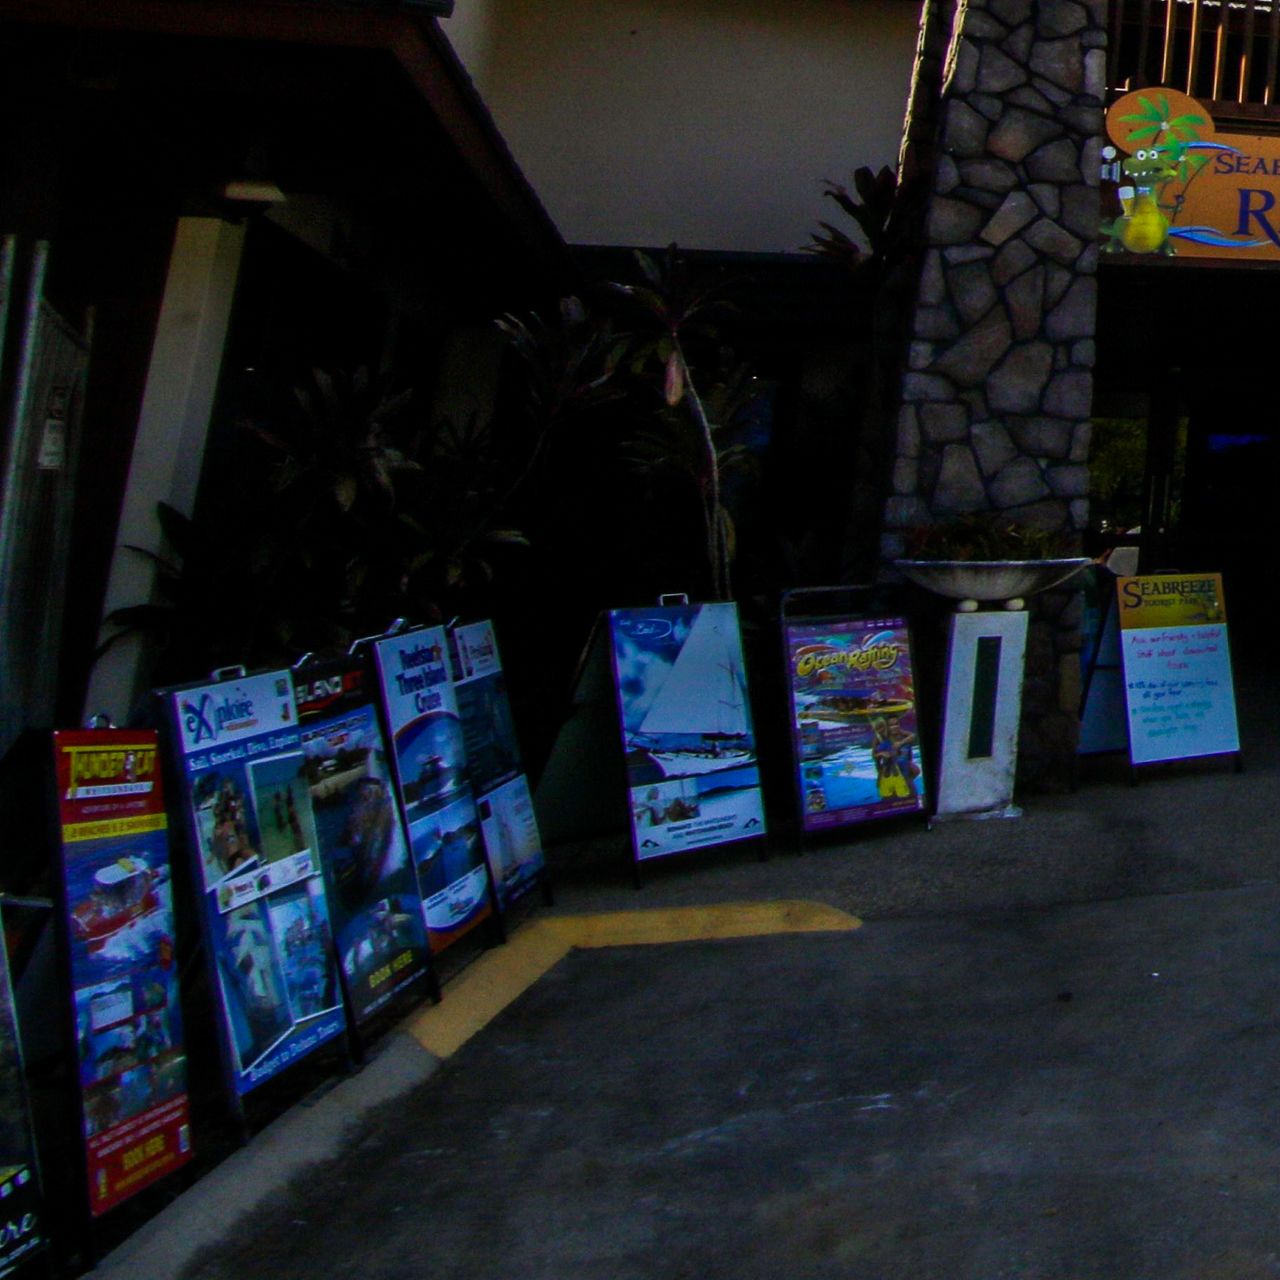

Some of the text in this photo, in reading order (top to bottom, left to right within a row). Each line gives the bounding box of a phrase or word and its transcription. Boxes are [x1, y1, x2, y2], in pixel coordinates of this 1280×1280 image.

[1123, 579, 1215, 608] SEABREEZE
[796, 641, 898, 676] Ocean Rafting
[296, 674, 343, 702] SLAND
